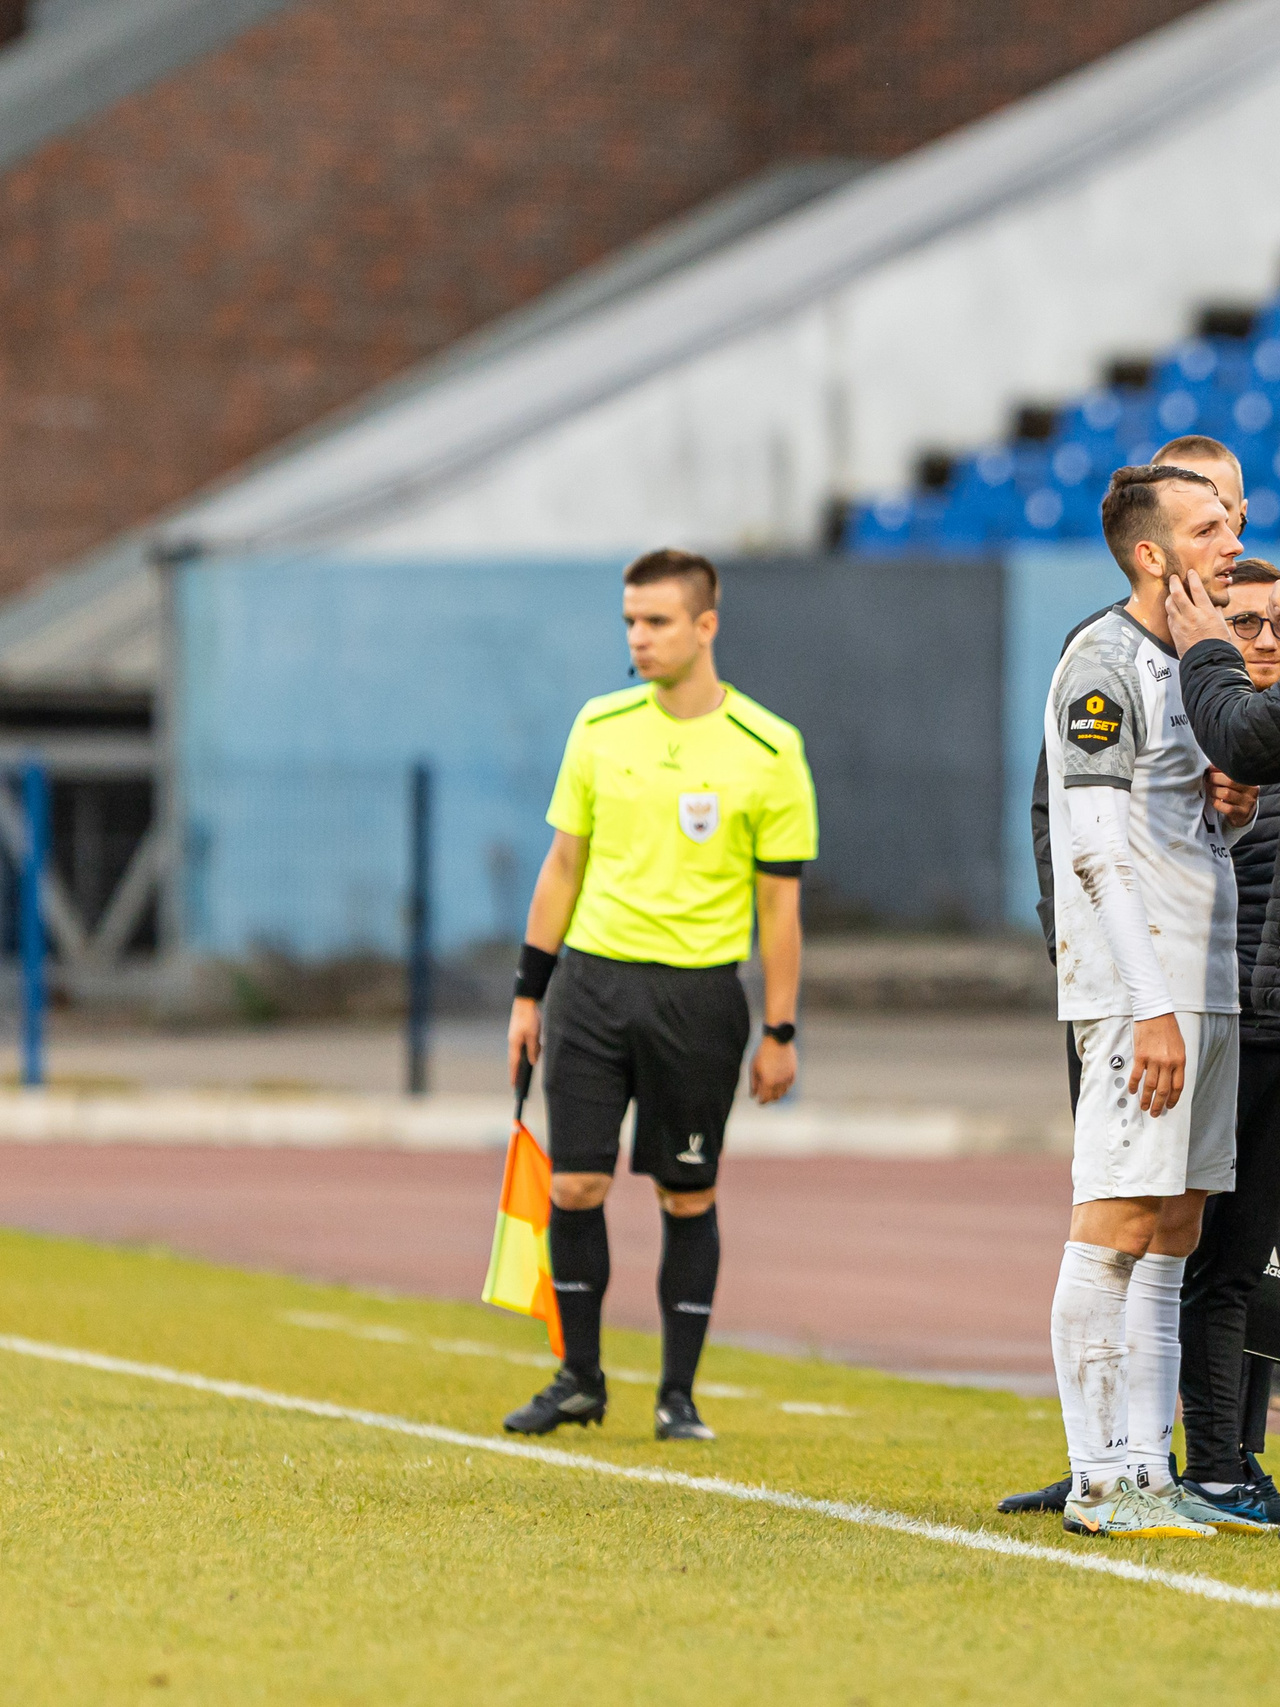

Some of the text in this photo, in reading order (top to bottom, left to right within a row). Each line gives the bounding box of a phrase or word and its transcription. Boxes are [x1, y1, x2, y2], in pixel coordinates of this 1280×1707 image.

[1092, 701, 1098, 709] 1
[1070, 719, 1119, 732] МЕЛБЕТ
[1170, 714, 1189, 727] JAKO
